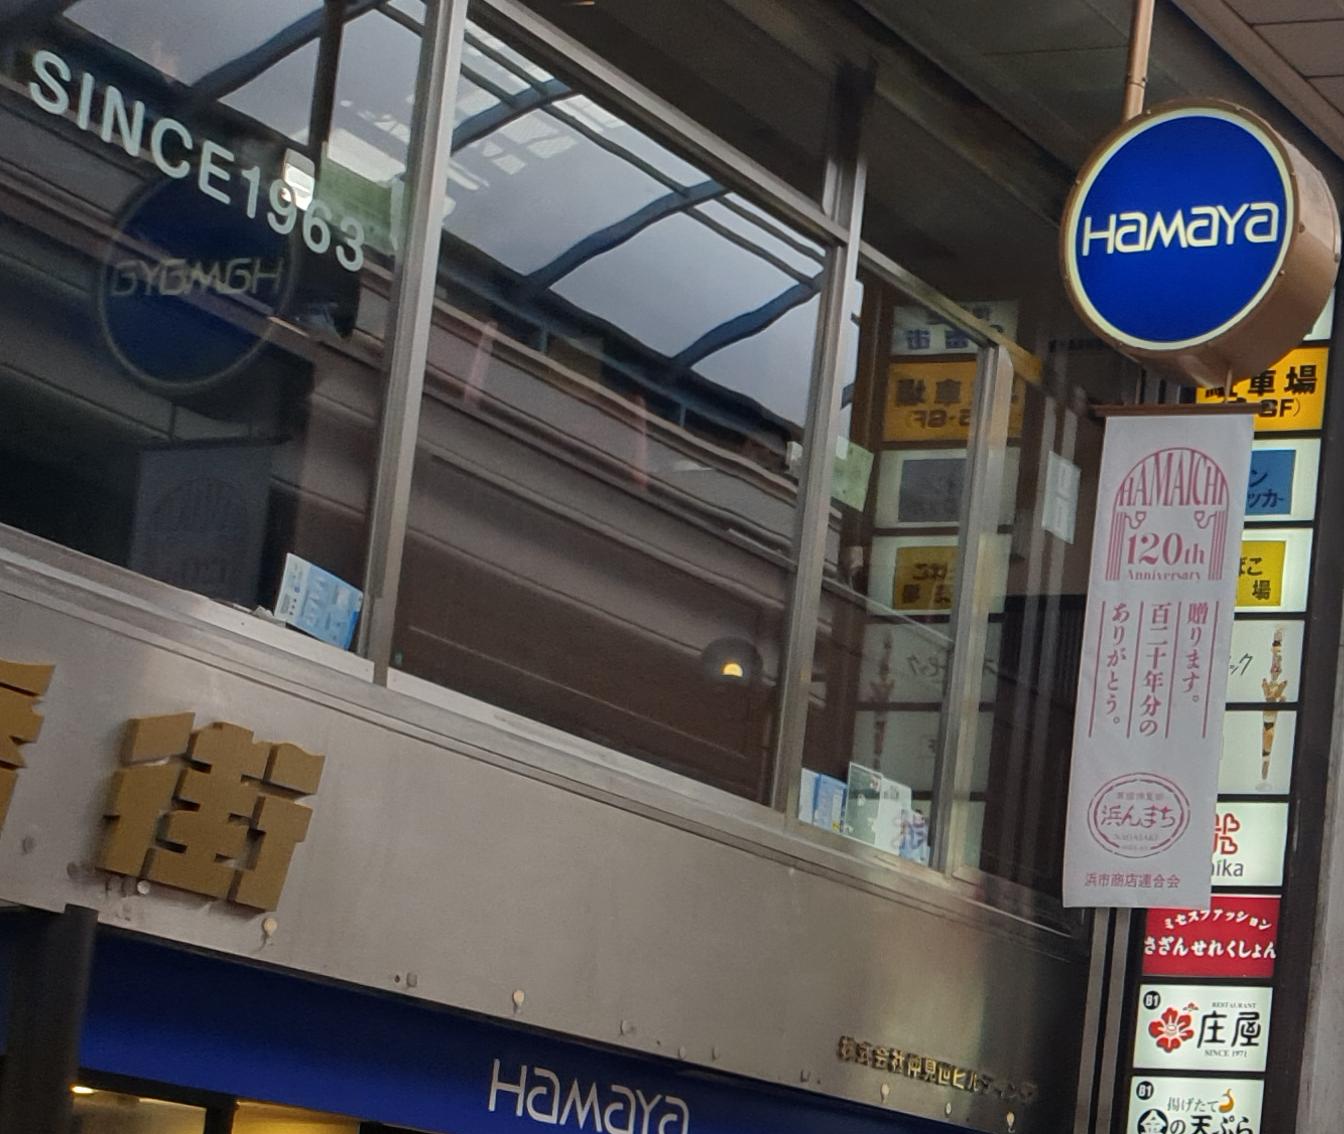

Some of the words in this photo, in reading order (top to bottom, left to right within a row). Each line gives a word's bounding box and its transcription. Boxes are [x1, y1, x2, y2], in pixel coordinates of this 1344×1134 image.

[1118, 452, 1228, 507] HAMAICHI
[1127, 533, 1206, 565] 120th
[1128, 569, 1202, 581] Anniversary
[1106, 602, 1130, 724] ありがとう。
[1139, 602, 1172, 737] 百二十年分の
[1182, 602, 1209, 703] 贈ります。
[1144, 936, 1277, 959] さざんせれくしょん
[1197, 1010, 1261, 1048] 庄屋
